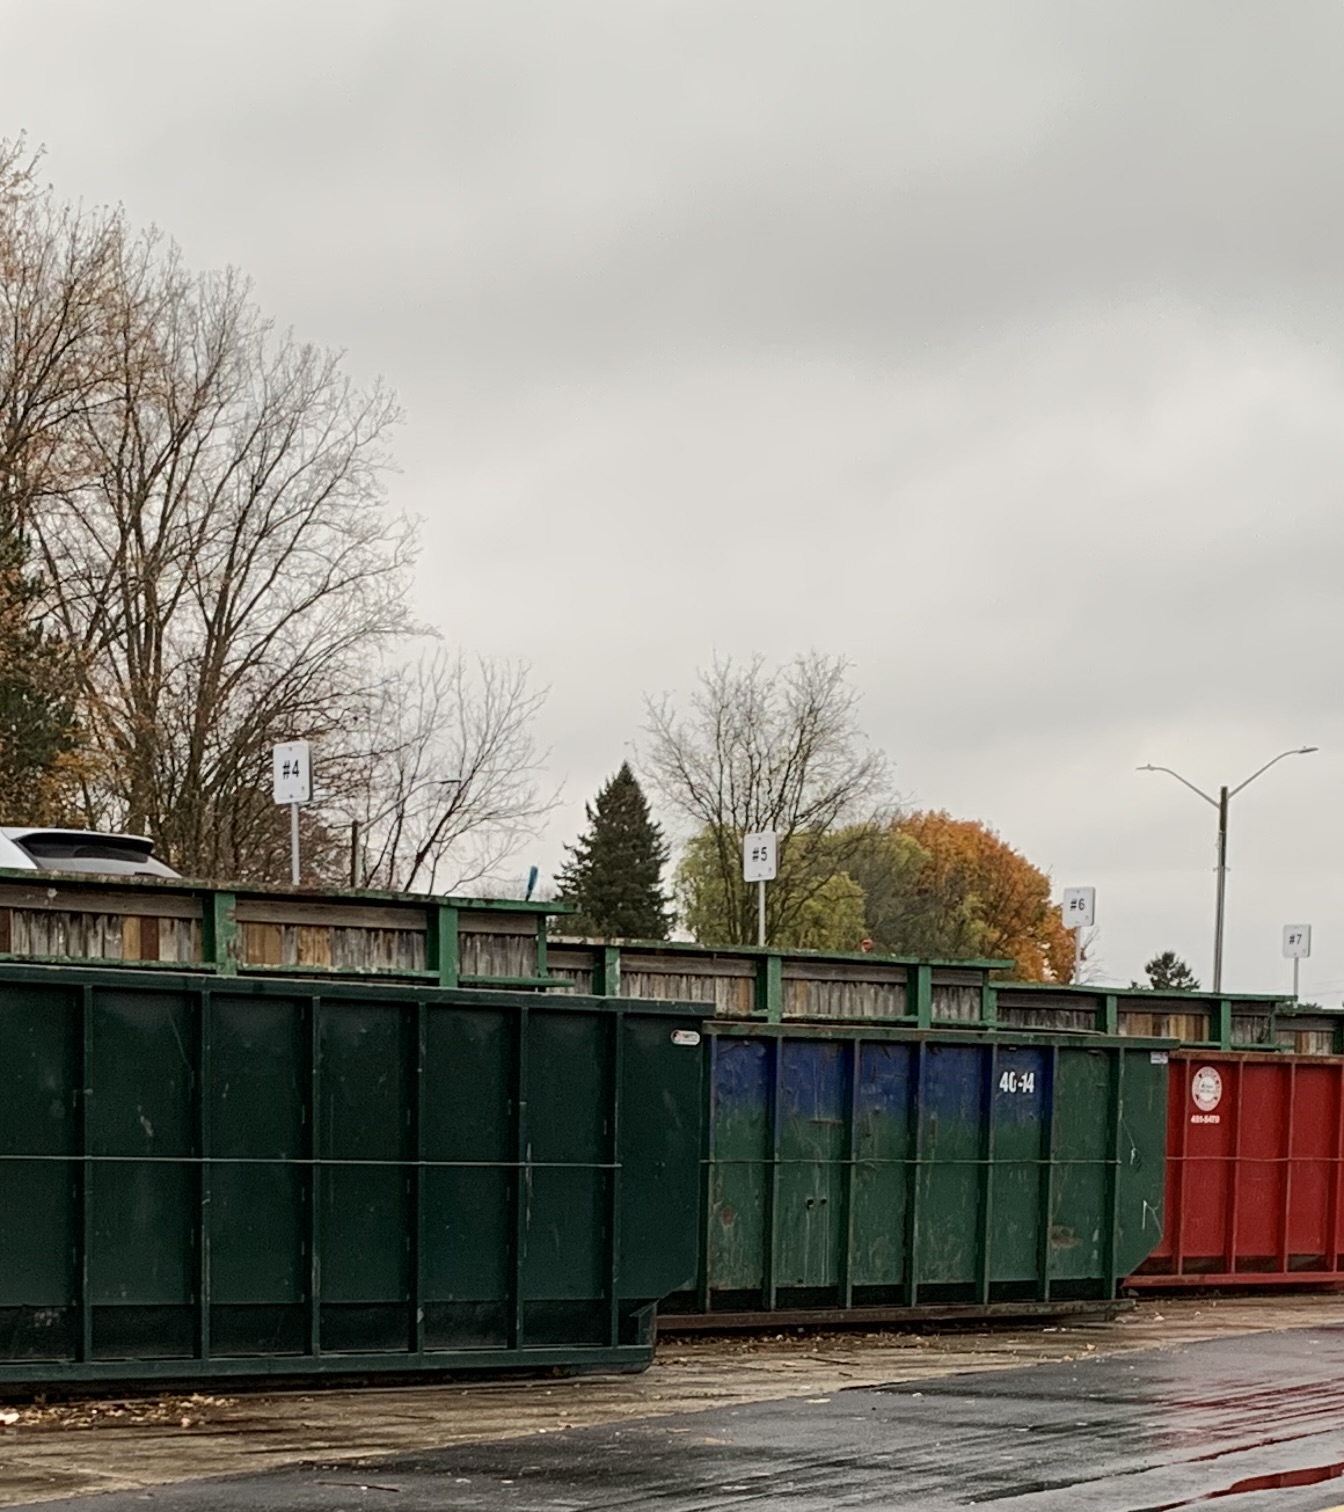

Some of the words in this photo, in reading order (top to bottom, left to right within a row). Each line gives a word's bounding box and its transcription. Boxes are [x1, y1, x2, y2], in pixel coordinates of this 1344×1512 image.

[283, 760, 299, 780] #4
[752, 846, 767, 862] #5
[1070, 898, 1085, 911] #6
[1289, 934, 1302, 945] #7
